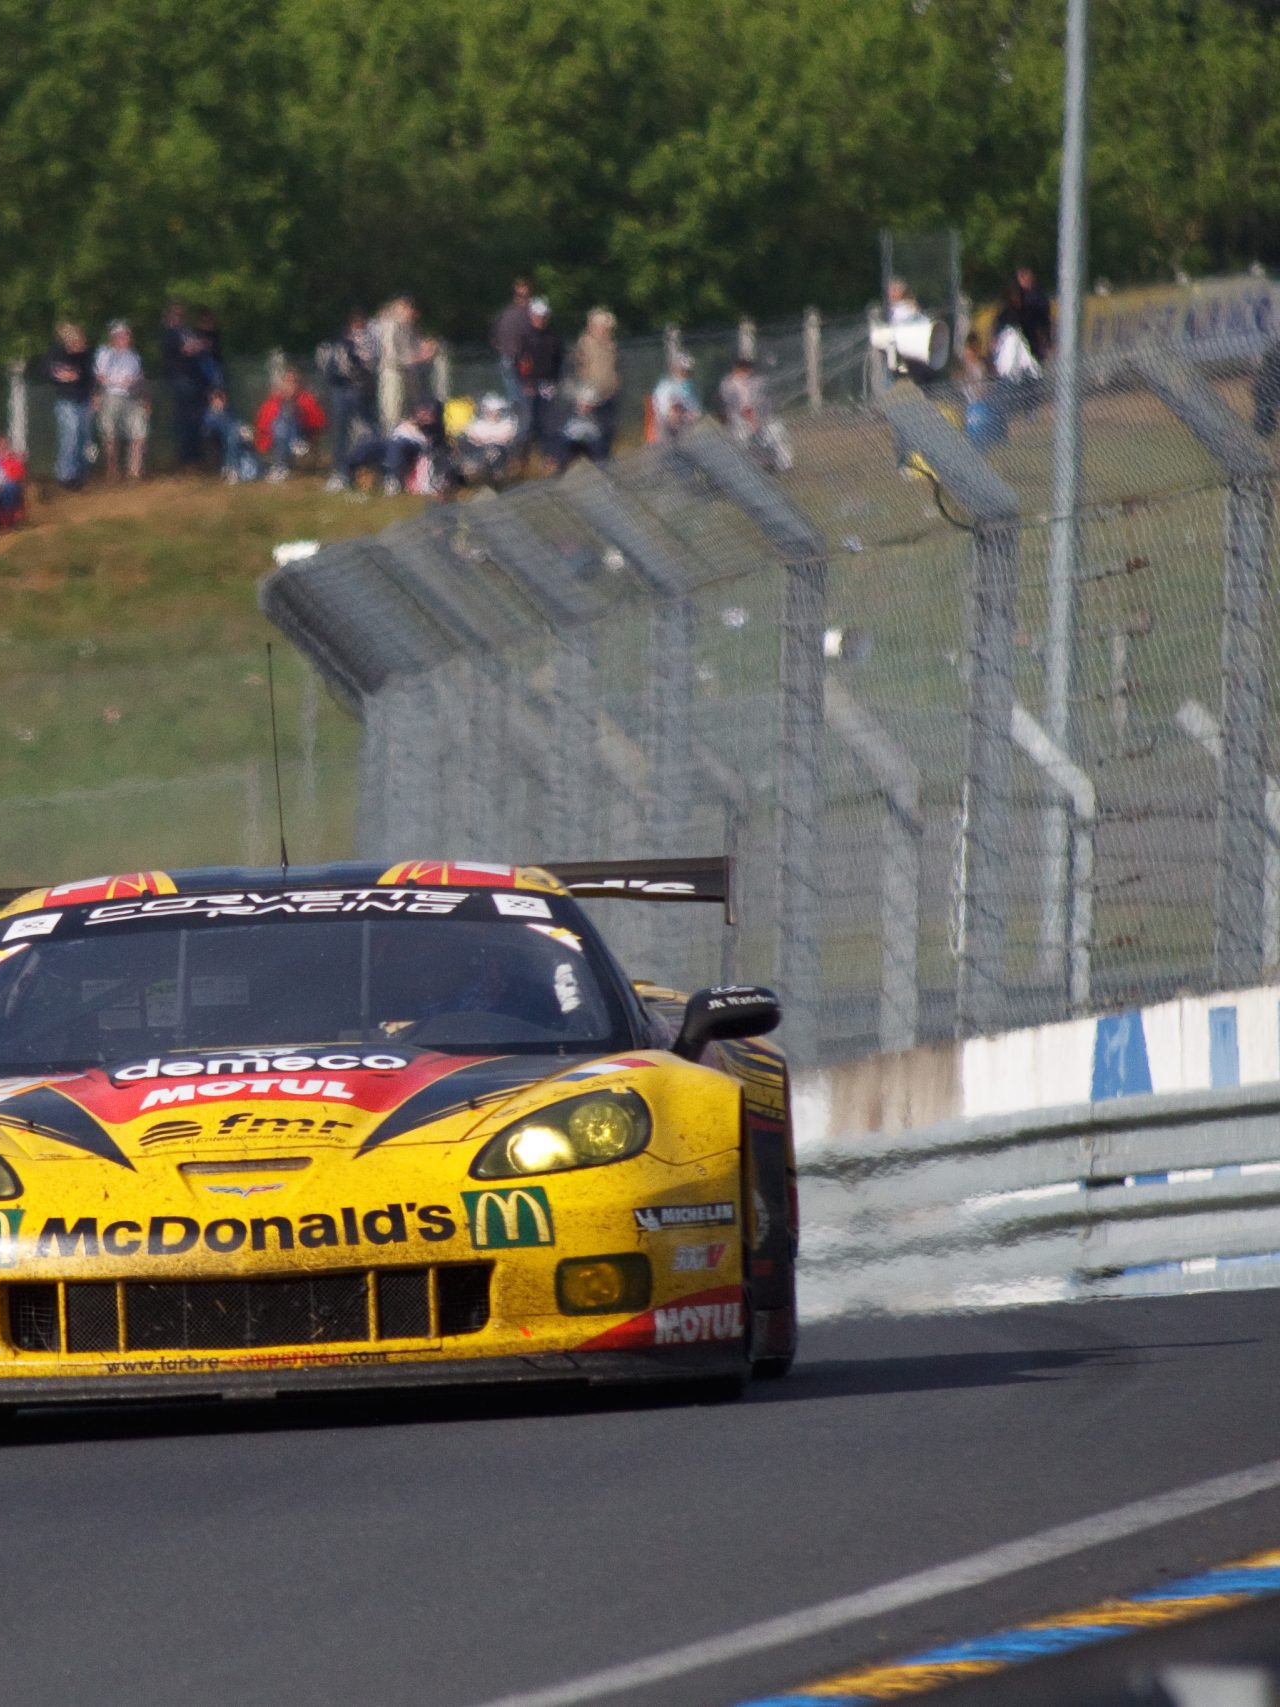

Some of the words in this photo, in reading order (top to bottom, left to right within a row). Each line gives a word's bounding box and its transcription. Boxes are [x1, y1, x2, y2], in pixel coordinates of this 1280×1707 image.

[84, 888, 470, 925] CORVETTE
[206, 900, 459, 918] RACING
[114, 1055, 408, 1081] demeco
[139, 1079, 355, 1110] MOTUL
[217, 1112, 354, 1135] fmr
[661, 1203, 734, 1224] MICHELIN
[35, 1202, 456, 1258] McDonald's
[654, 1302, 745, 1345] MOTUL
